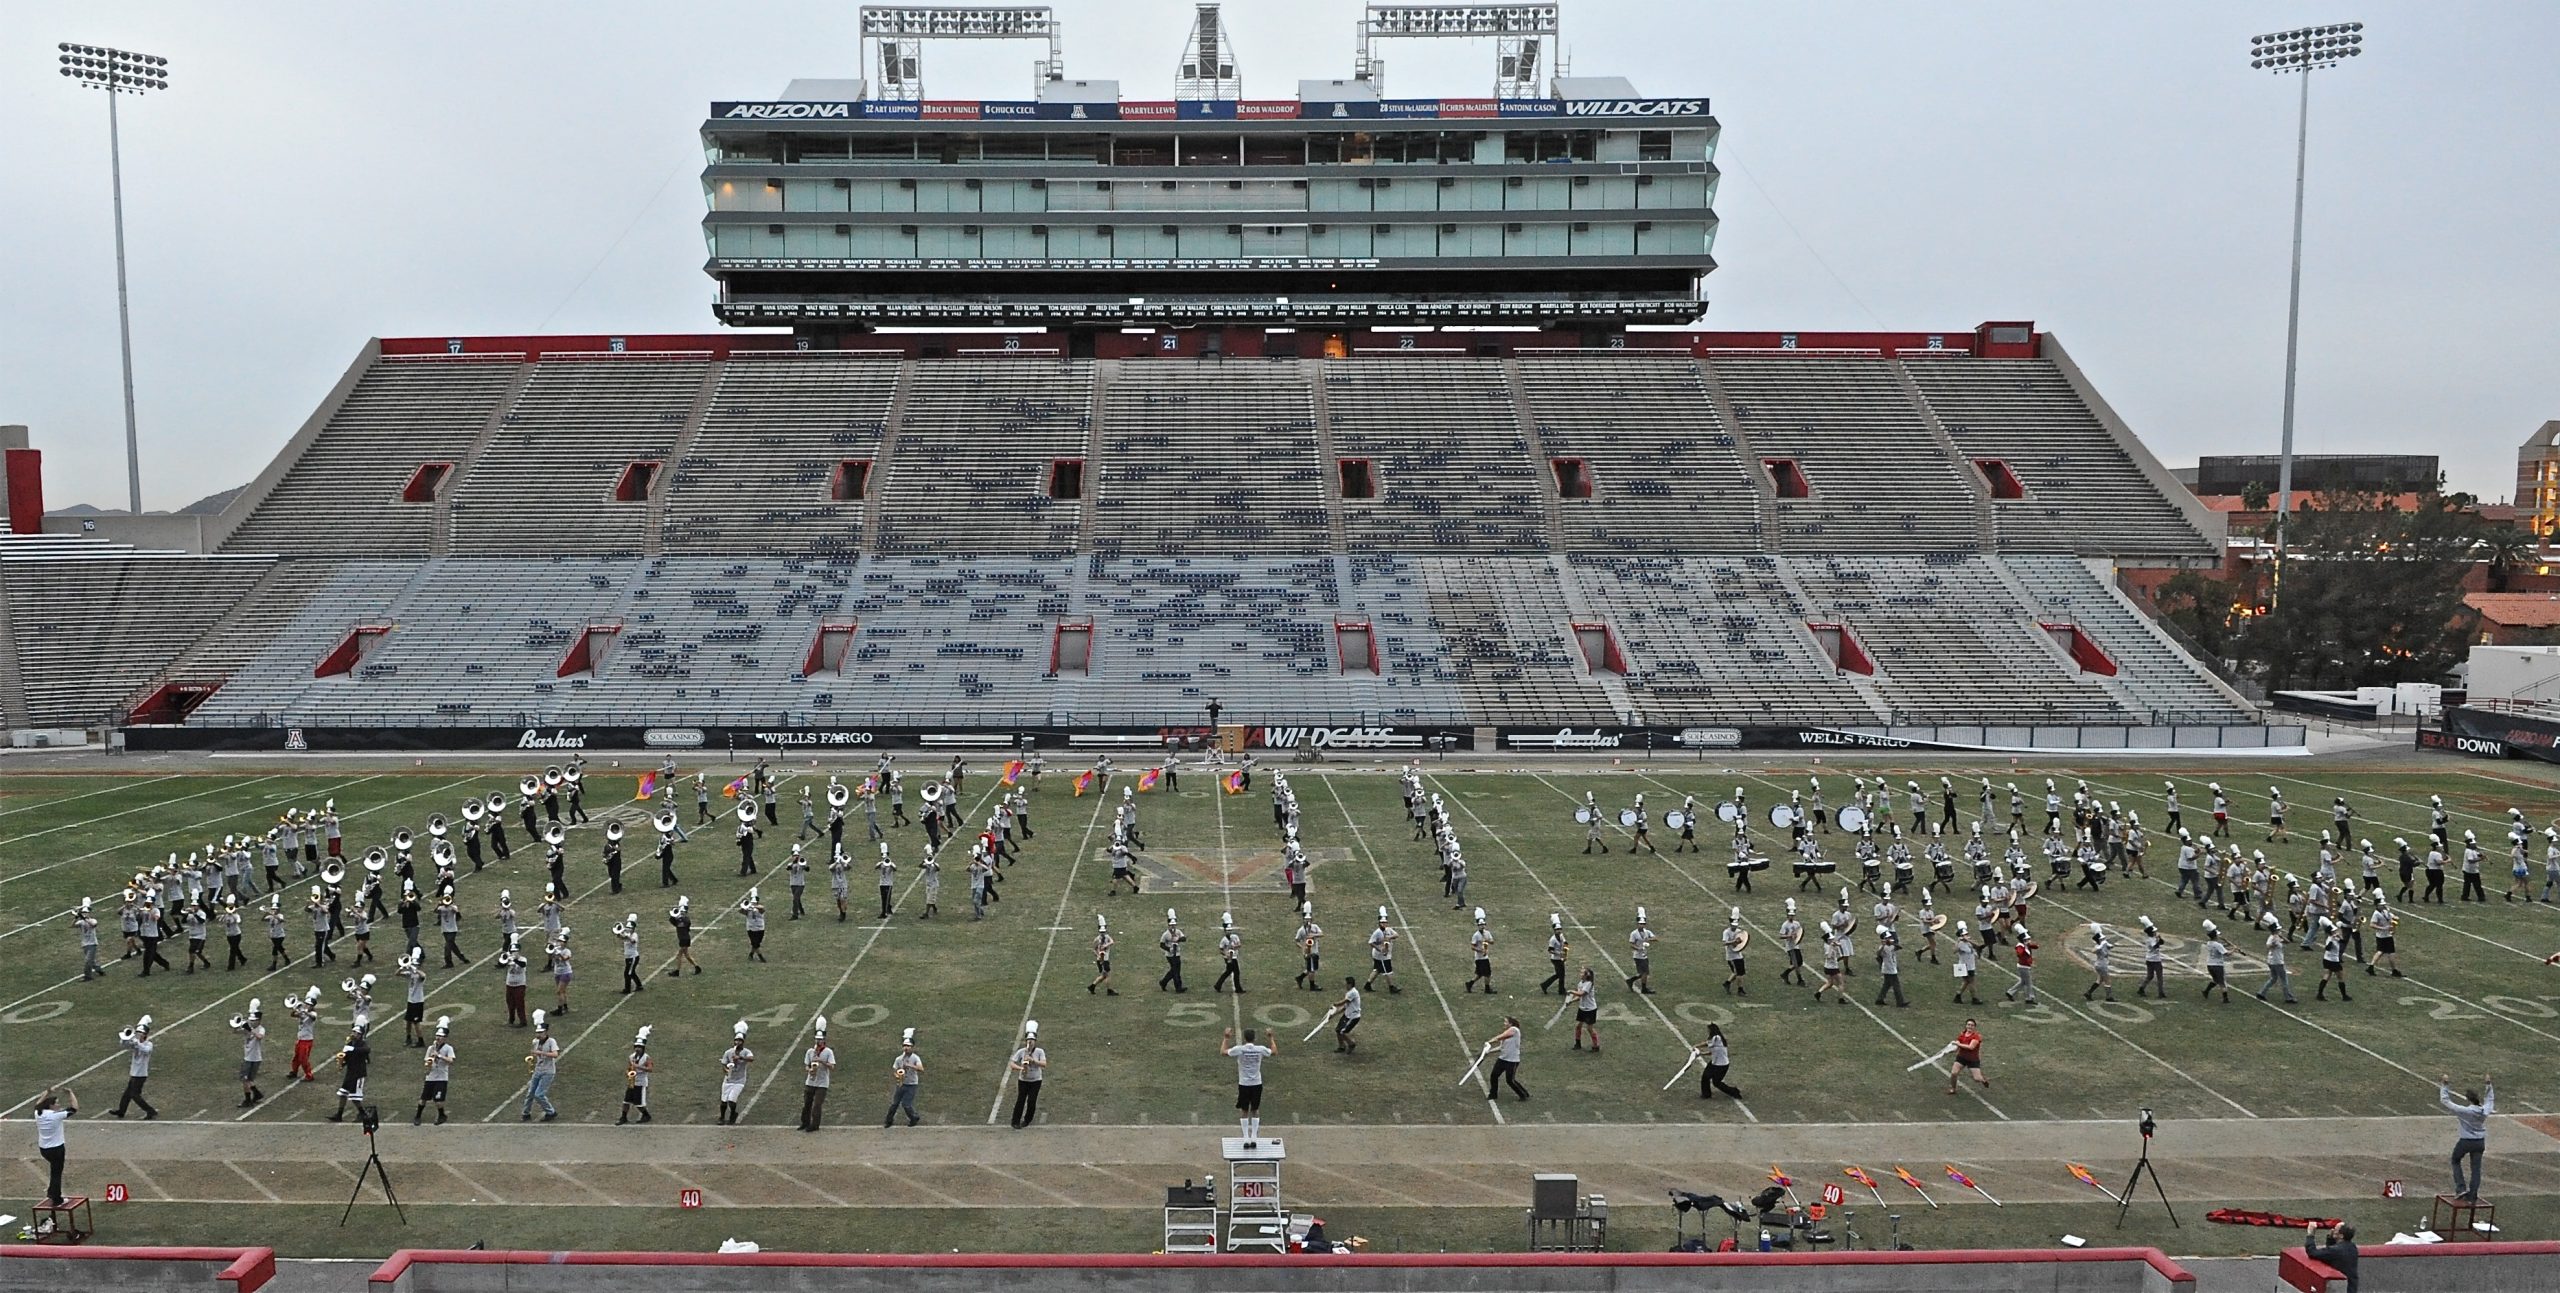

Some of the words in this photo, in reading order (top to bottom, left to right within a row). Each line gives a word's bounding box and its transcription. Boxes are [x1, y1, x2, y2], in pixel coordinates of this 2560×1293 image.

[725, 104, 848, 118] ARIZONA
[866, 105, 874, 113] 22
[889, 106, 918, 114] LUPPINO
[953, 106, 979, 114] HUNLEY
[991, 106, 1014, 114] CHUCK
[1016, 106, 1035, 114] CECIL
[1119, 106, 1124, 114] 4
[1125, 106, 1154, 114] DARRYLL
[1155, 106, 1176, 114] LEWIS
[1446, 104, 1464, 112] CHRIS
[1500, 103, 1504, 111] 5
[1505, 104, 1532, 112] ANTOINE
[1534, 104, 1556, 112] CASON
[1566, 102, 1702, 115] WILDCATS
[450, 344, 461, 354] 17
[612, 343, 624, 352] 18
[797, 341, 809, 350] 19
[1005, 340, 1019, 350] 20
[1164, 340, 1176, 349] 21
[1400, 340, 1414, 348] 22
[1611, 339, 1624, 348] 23
[1782, 340, 1796, 348] 24
[1928, 340, 1942, 350] 25
[84, 522, 94, 530] 16
[286, 729, 306, 749] A
[518, 730, 587, 748] Bashas'
[764, 733, 816, 744] WELLS
[821, 733, 872, 744] FARGO
[1800, 732, 1854, 744] WELLS
[2422, 734, 2456, 748] BEAR
[2457, 738, 2500, 754] DOWN
[1598, 1001, 1735, 1025] 40
[1998, 1001, 2154, 1024] 30
[2396, 996, 2558, 1020] 20
[739, 1003, 889, 1028] 40
[1165, 1003, 1311, 1028] 50
[108, 1186, 124, 1201] 30
[1246, 1183, 1261, 1197] 50
[1824, 1186, 1839, 1203] 40
[2388, 1182, 2402, 1197] 30
[683, 1191, 698, 1207] 40
